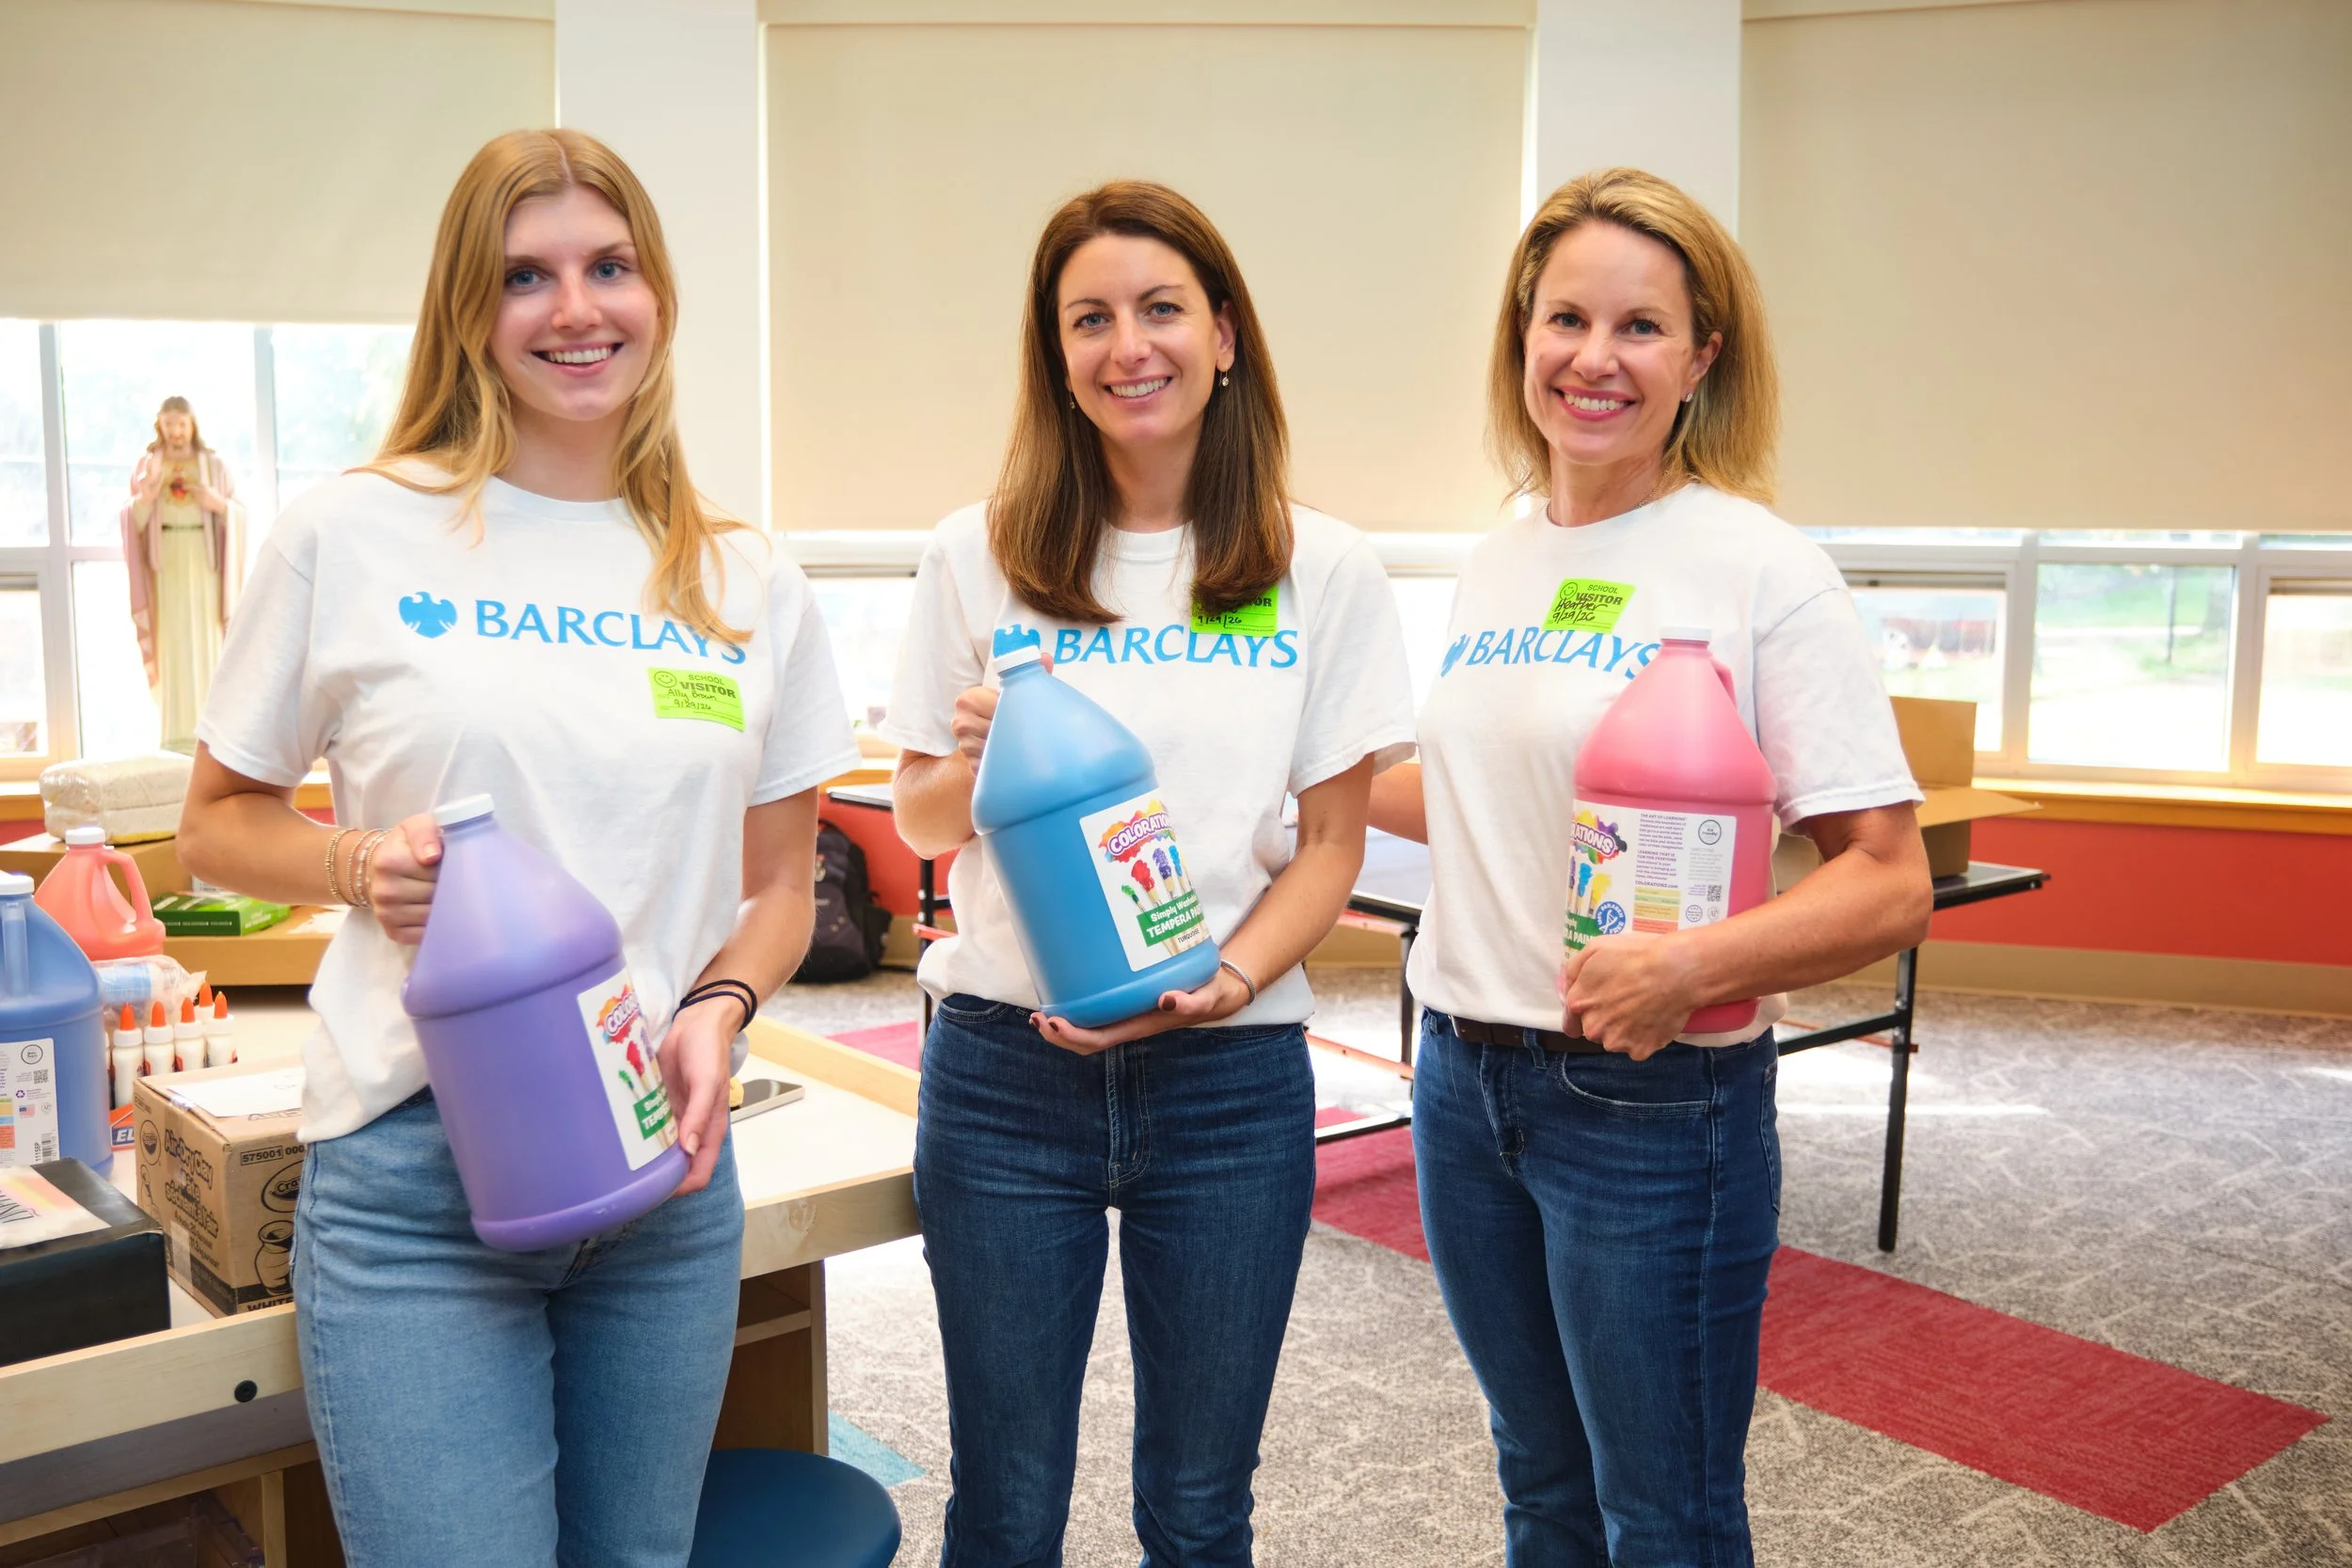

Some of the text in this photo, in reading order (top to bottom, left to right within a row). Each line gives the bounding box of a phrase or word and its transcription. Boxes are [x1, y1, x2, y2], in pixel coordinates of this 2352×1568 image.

[1587, 584, 1618, 594] SCHOOL
[1554, 597, 1608, 612] Heather
[1576, 593, 1624, 606] VISITOR
[474, 599, 746, 665] BARCLAYS
[1053, 625, 1298, 669] BARCLAYS
[1465, 626, 1662, 681] BARCLAYS
[688, 674, 725, 685] SCHOOL
[679, 681, 736, 698] VISITOR
[1151, 905, 1178, 922] Simply
[1146, 911, 1192, 939] TEMPERA
[1178, 927, 1200, 943] TURQUOISE
[242, 1148, 282, 1163] 575001
